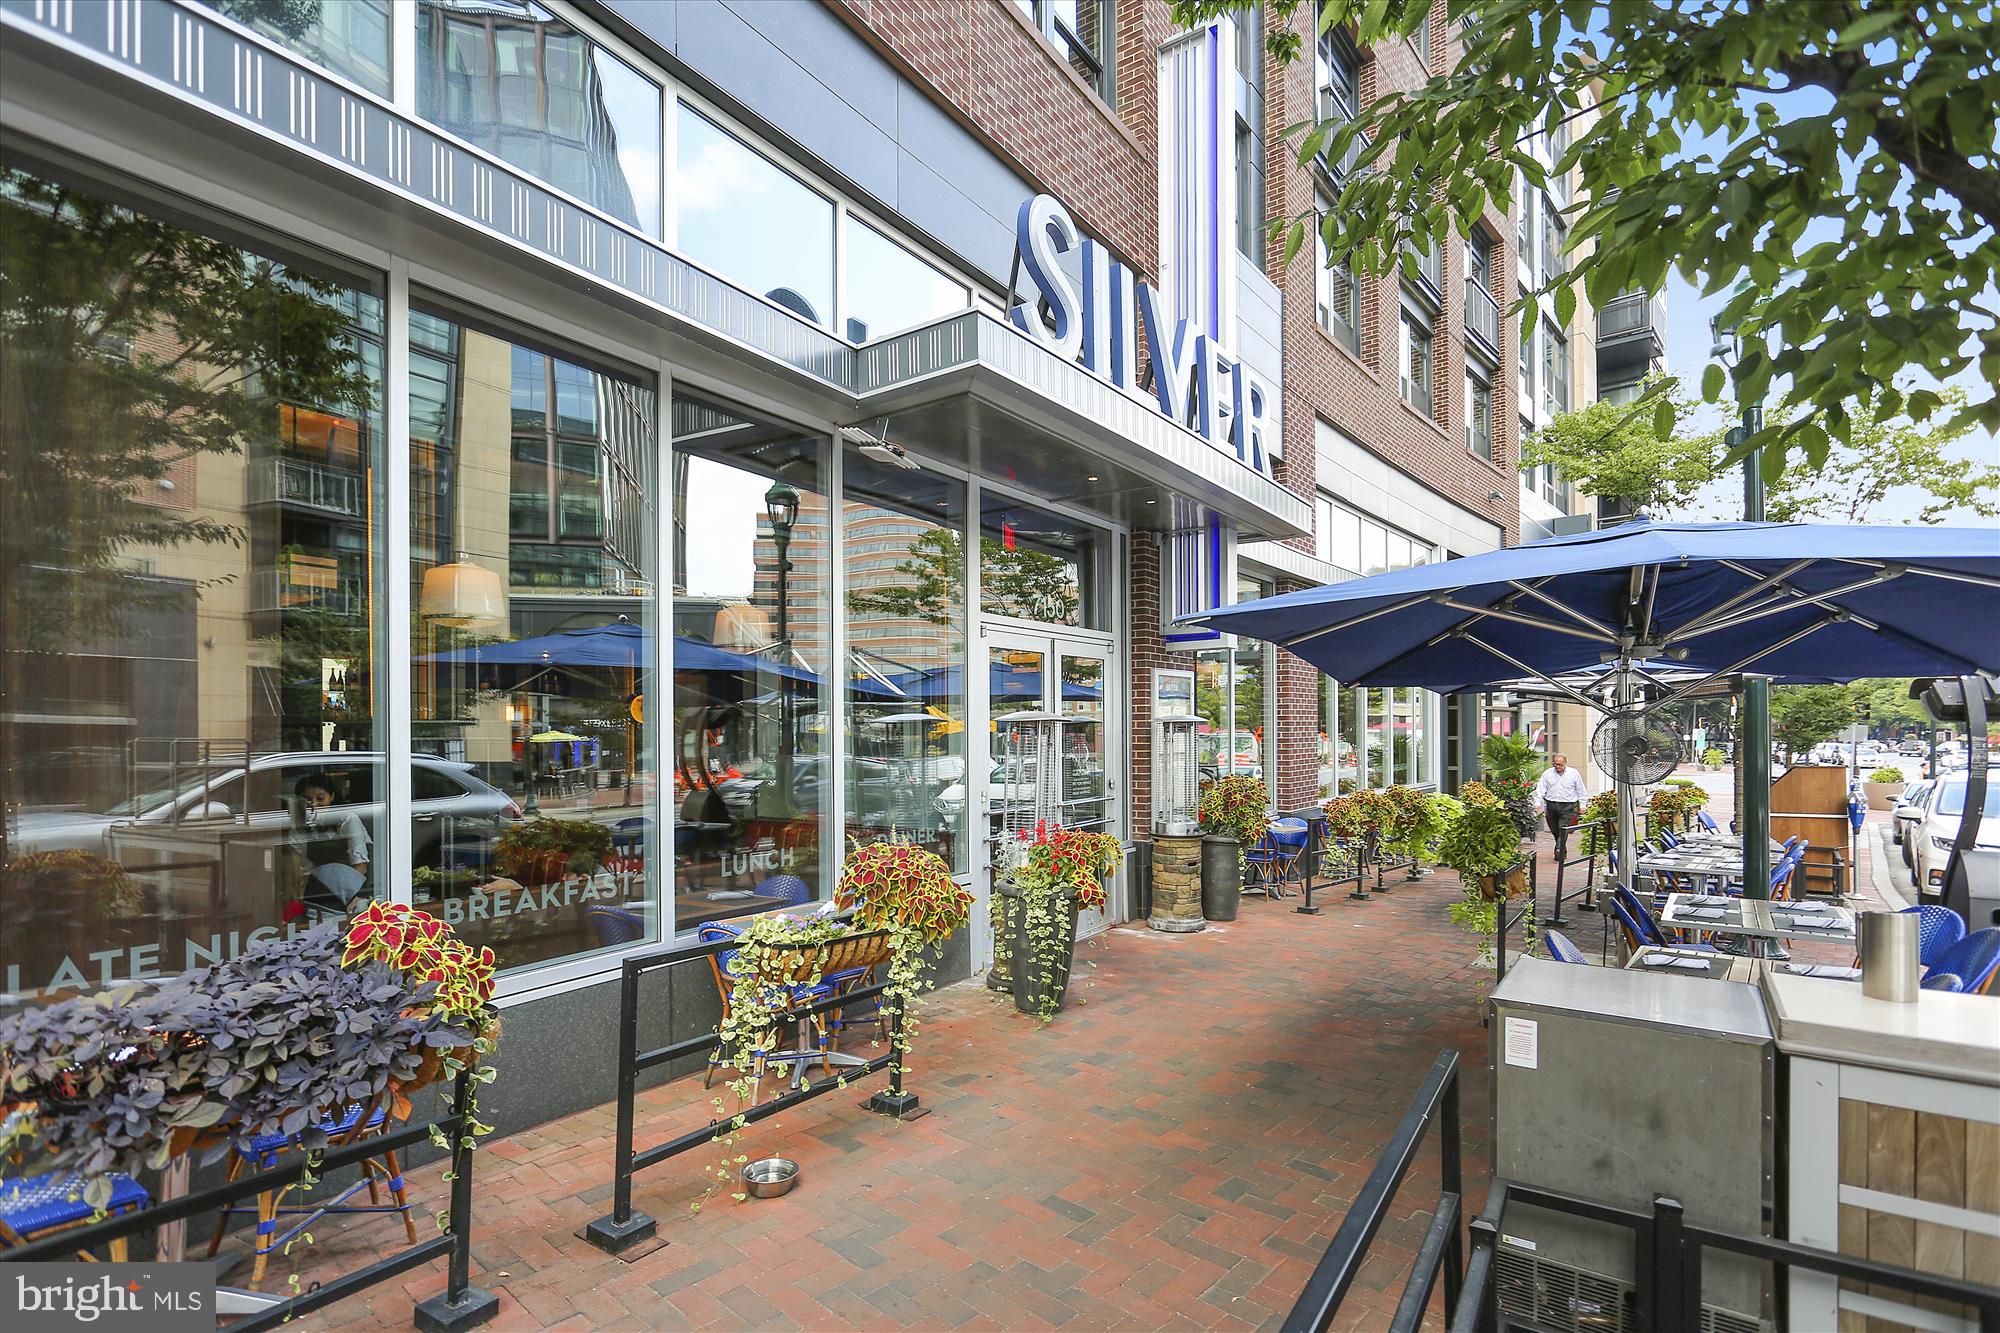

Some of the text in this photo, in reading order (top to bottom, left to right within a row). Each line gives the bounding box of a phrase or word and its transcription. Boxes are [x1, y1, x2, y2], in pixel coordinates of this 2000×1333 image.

[1010, 193, 1274, 480] SILVER
[720, 847, 795, 877] LUNCH
[444, 871, 634, 925] BREAKFAST
[7, 943, 160, 1000] LATE
